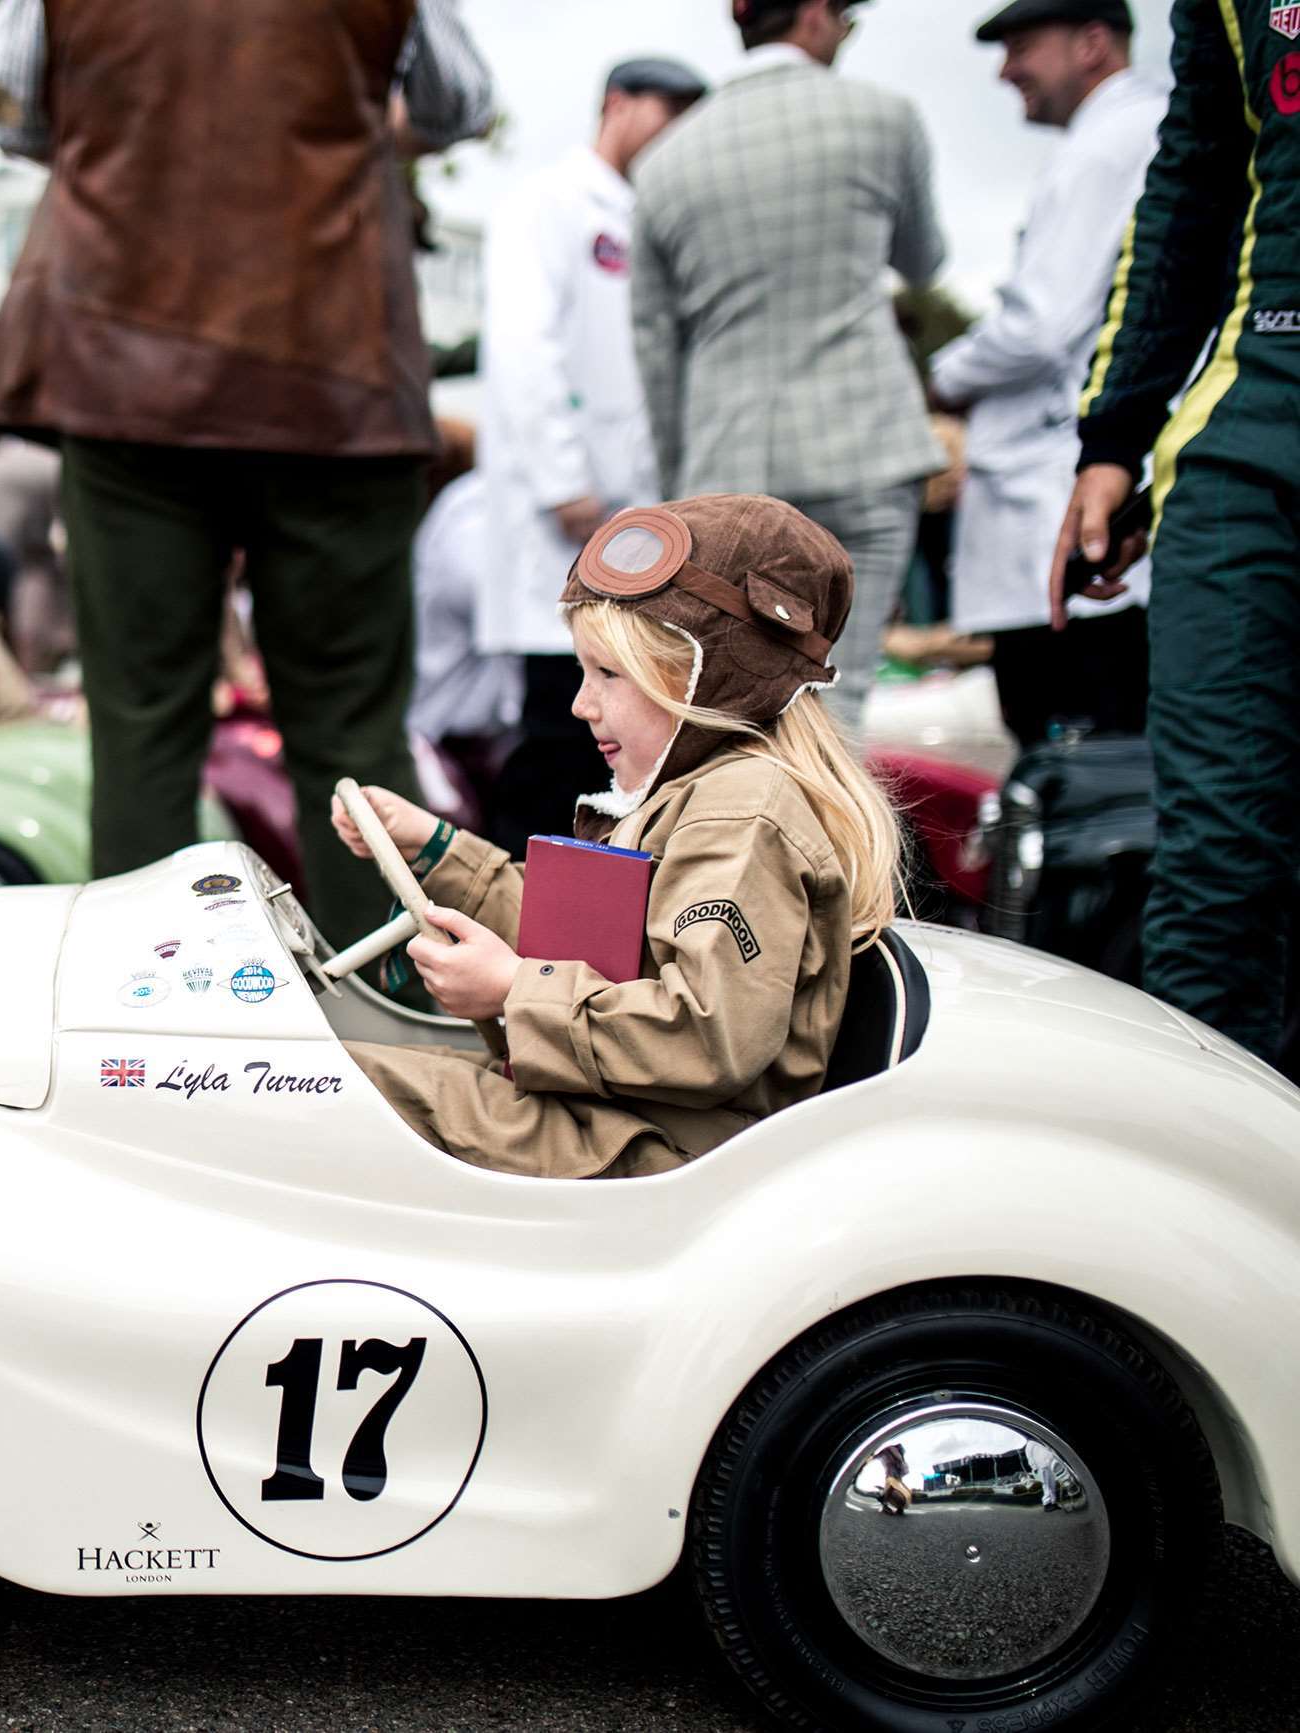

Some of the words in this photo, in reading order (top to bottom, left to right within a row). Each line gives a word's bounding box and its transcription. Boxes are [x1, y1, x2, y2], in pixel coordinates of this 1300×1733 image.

[677, 904, 753, 954] GOODWOOD
[243, 1061, 343, 1094] Turner
[261, 1337, 427, 1502] 17
[76, 1547, 221, 1571] HACKETT
[125, 1575, 172, 1583] LONDON
[1088, 1621, 1151, 1695] POWER
